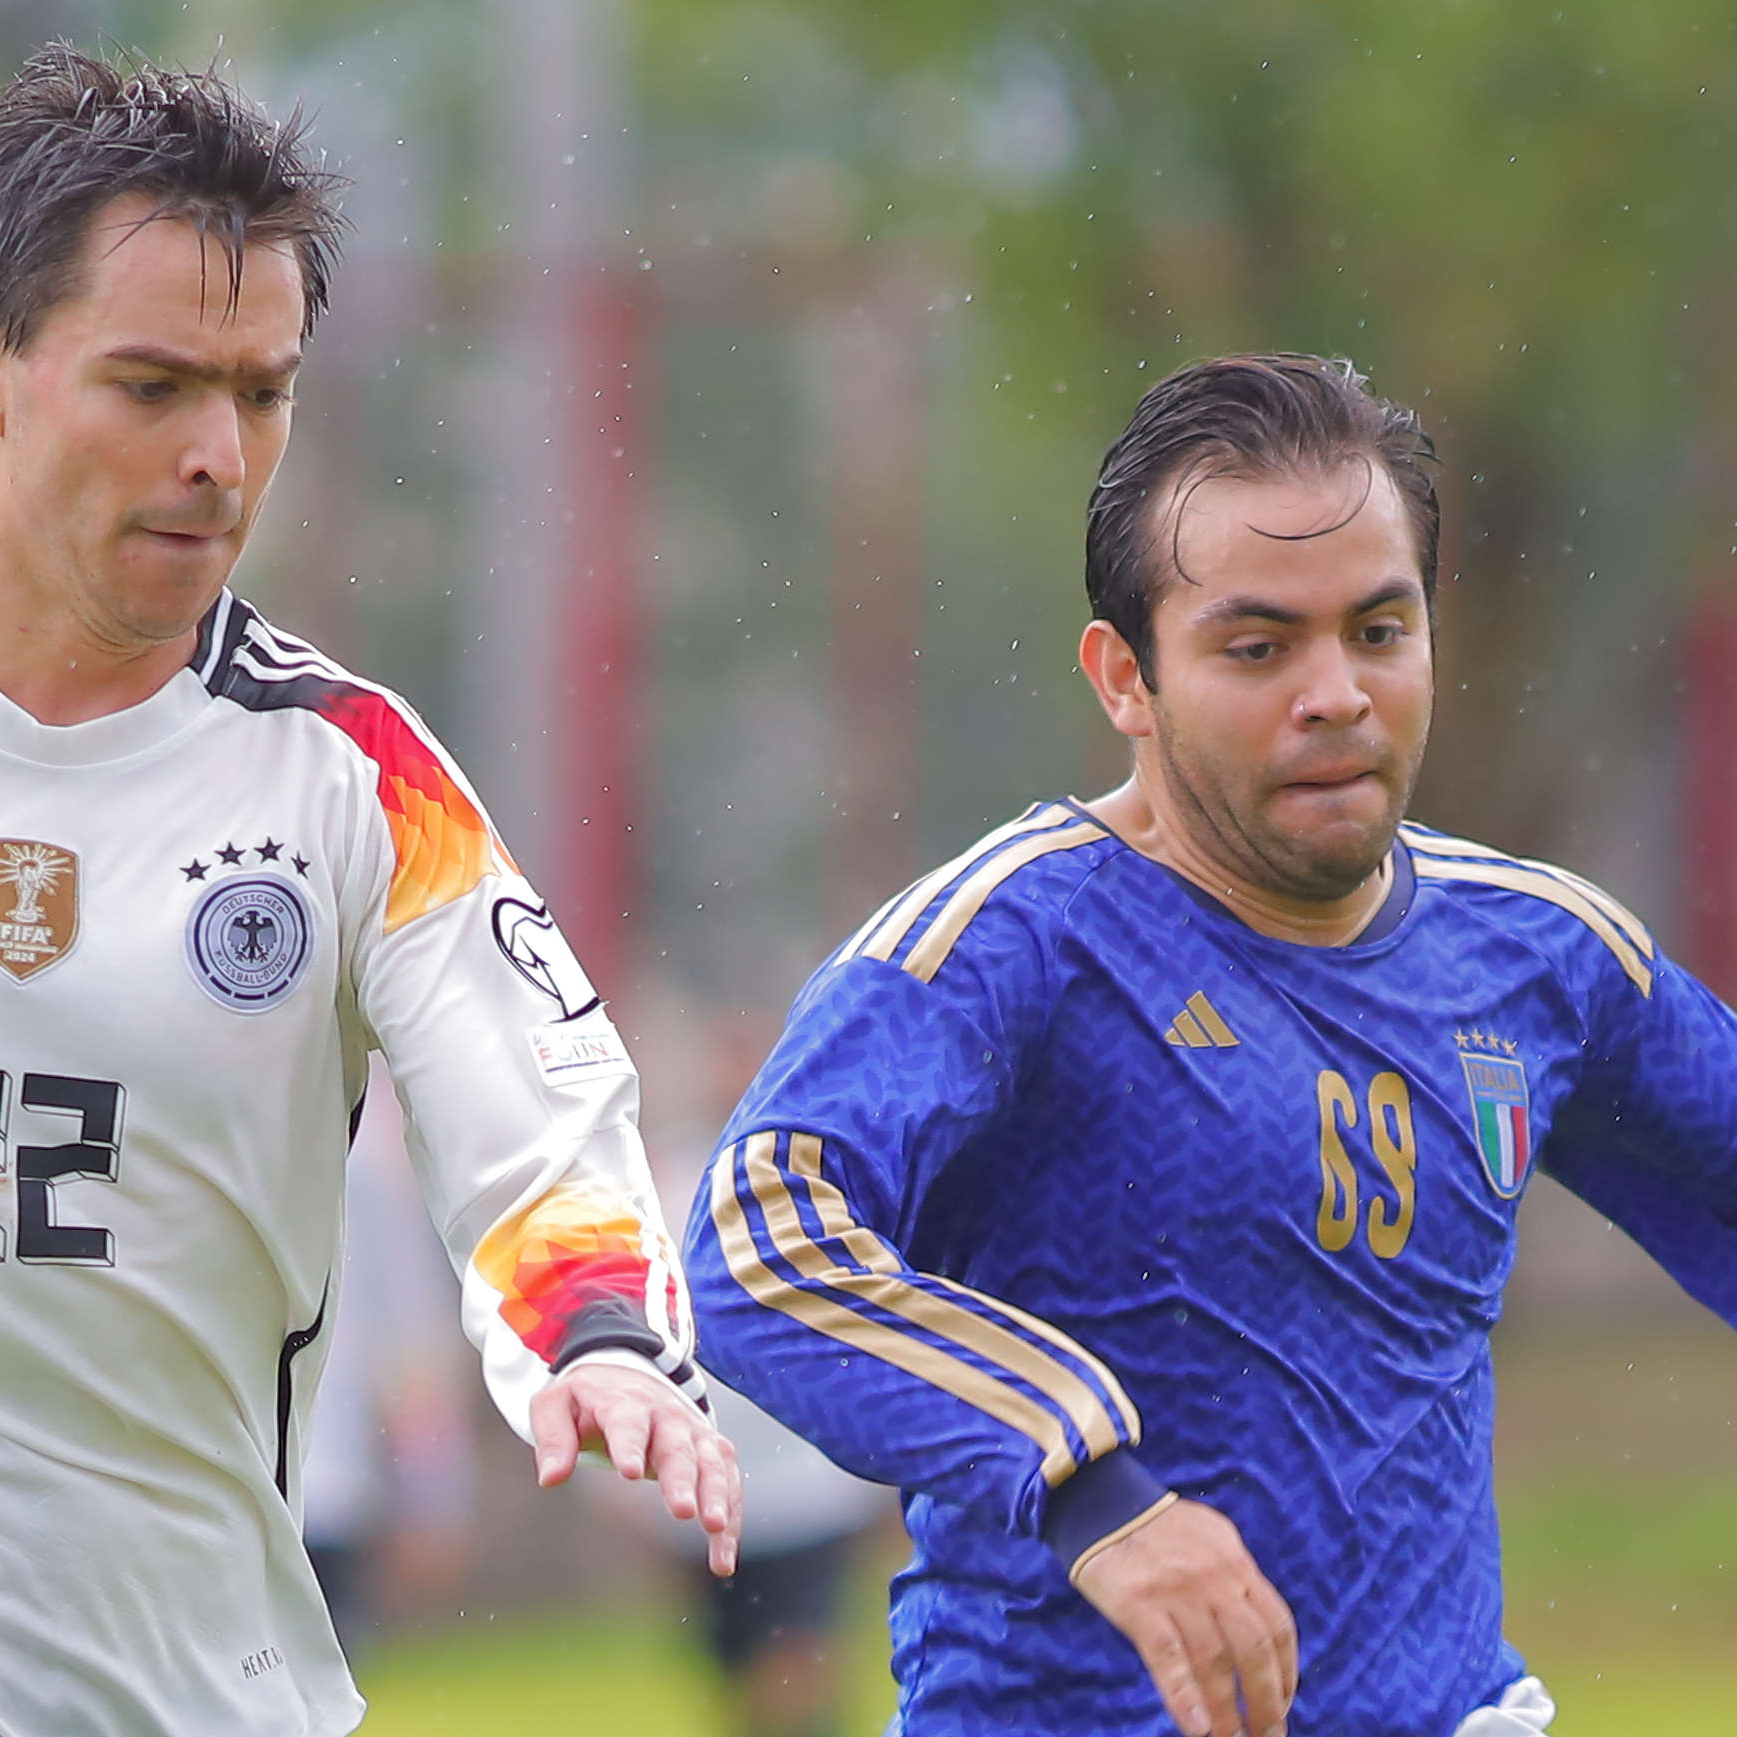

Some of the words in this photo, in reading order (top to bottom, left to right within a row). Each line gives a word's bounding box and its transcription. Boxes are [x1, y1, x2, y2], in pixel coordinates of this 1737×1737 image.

[222, 893, 286, 915] DEUTSCHER
[0, 923, 50, 945] FIFA
[1467, 1063, 1522, 1090] ITALIA
[1317, 1069, 1416, 1259] 69
